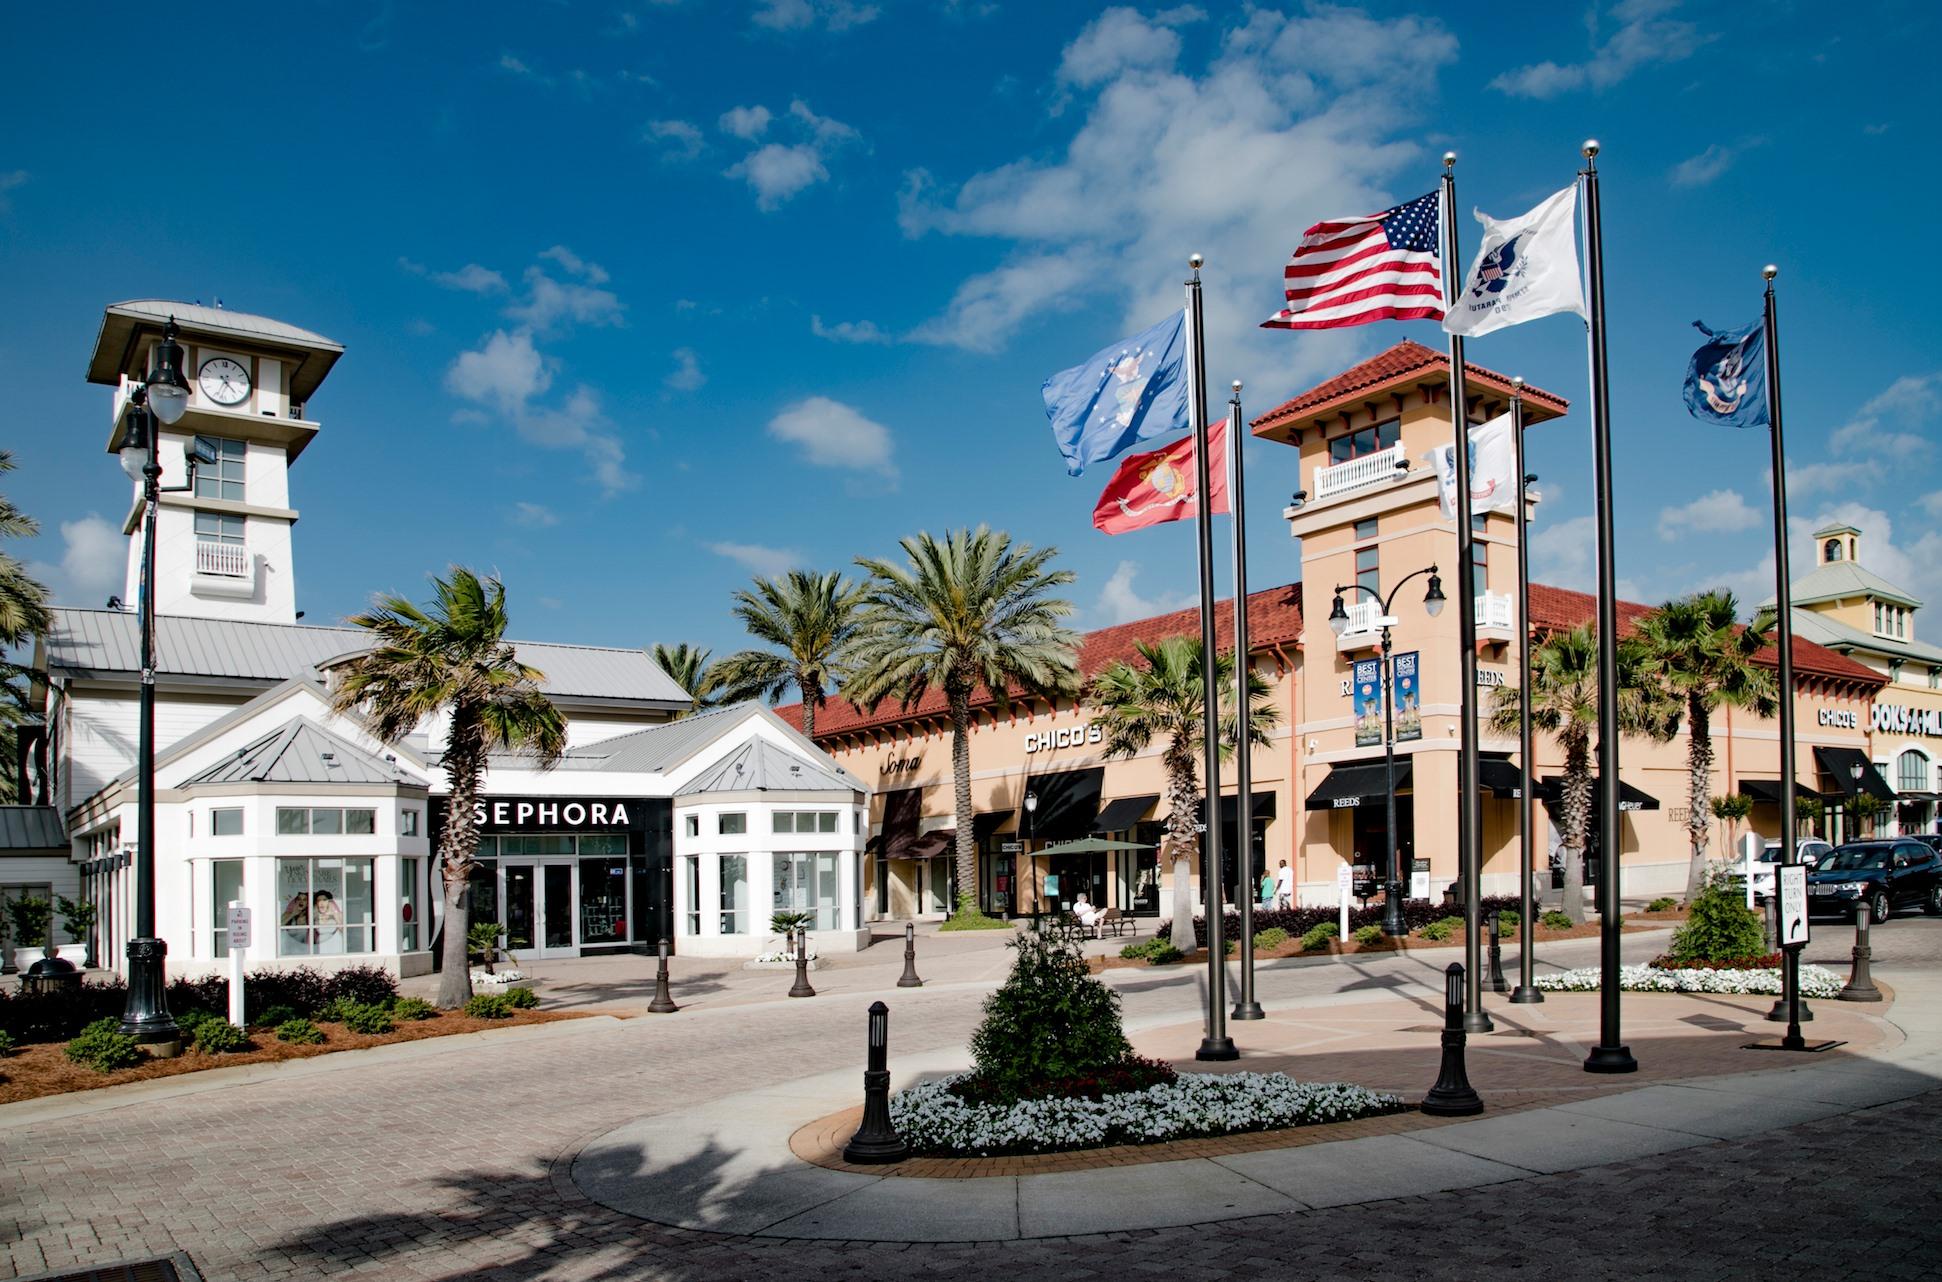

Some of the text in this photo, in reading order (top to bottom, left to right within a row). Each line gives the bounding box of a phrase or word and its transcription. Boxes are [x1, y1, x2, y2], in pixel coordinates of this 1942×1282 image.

[1357, 662, 1377, 674] BEST
[1397, 655, 1416, 667] BEST
[1477, 669, 1505, 686] EEDS
[1819, 708, 1857, 729] CHICO'S
[1024, 724, 1102, 753] CHICO'S
[880, 751, 921, 775] Soma
[1333, 797, 1360, 808] REEDS
[473, 802, 630, 825] SEPHORA
[1668, 807, 1690, 822] REED
[1783, 873, 1803, 886] RIGHT
[1784, 887, 1802, 900] TURN
